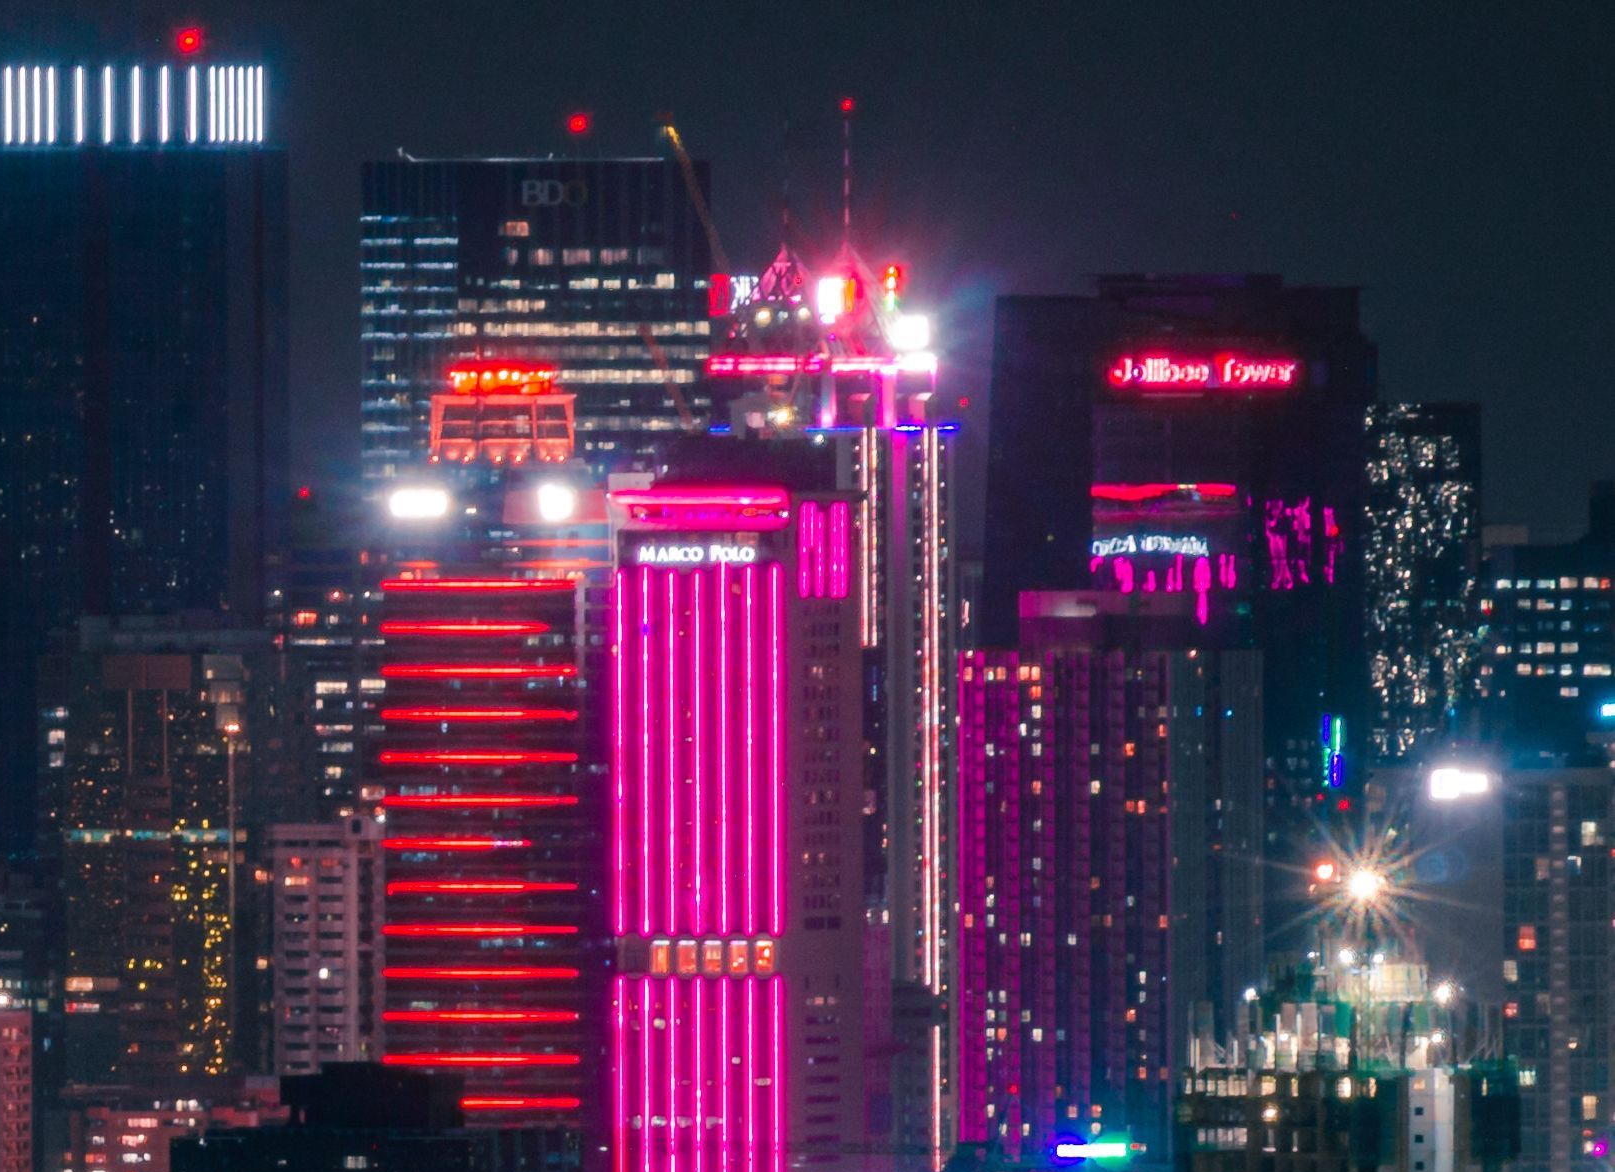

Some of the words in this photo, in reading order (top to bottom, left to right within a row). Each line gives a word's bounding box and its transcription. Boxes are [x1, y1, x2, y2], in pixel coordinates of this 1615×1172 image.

[521, 179, 589, 207] BDO
[639, 545, 705, 562] MARCO
[709, 544, 756, 562] POLO
